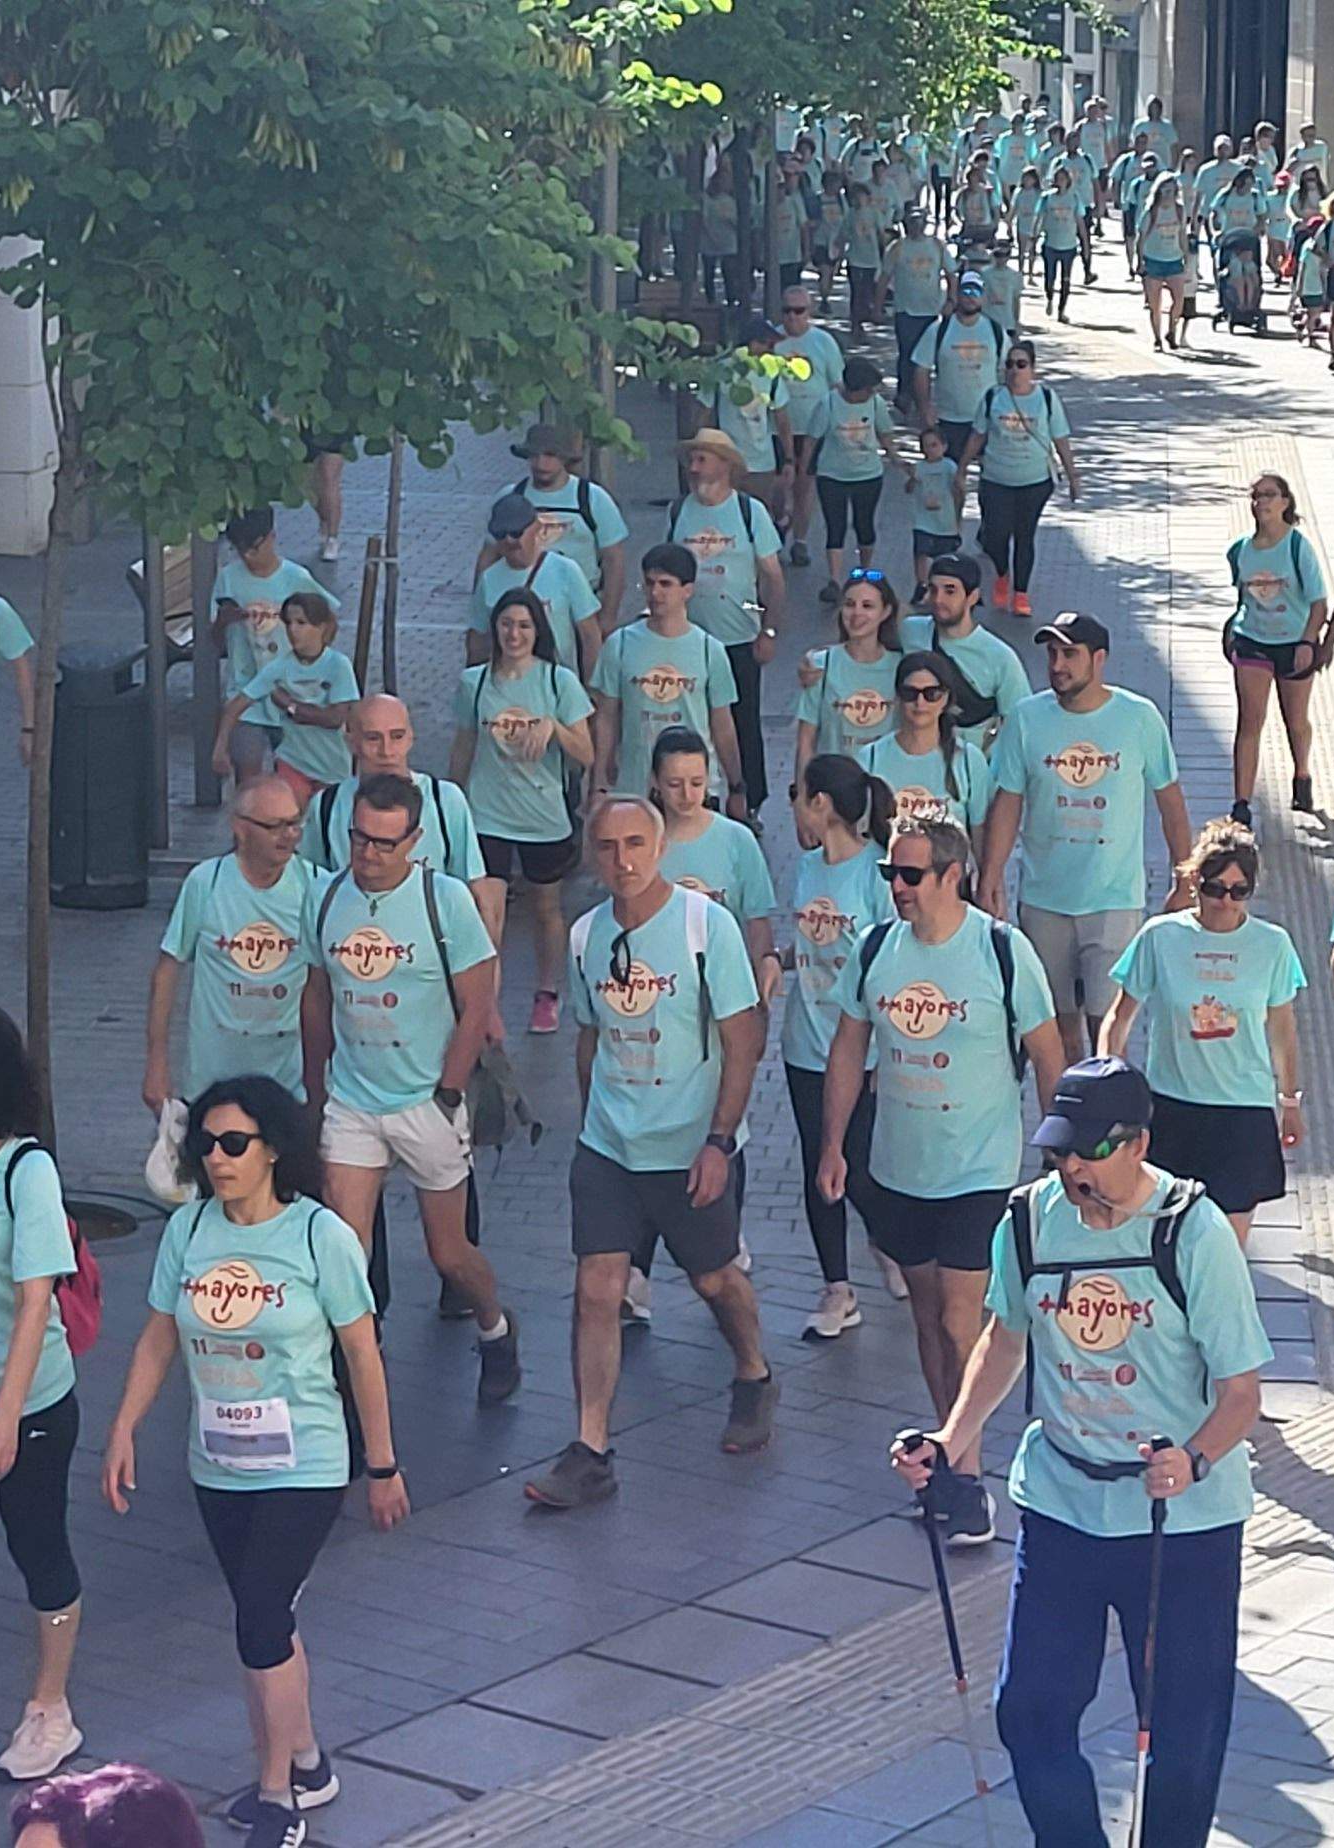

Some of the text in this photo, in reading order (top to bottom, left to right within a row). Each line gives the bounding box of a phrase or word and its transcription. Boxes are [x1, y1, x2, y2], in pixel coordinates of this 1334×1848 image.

[329, 941, 416, 968] +mayores
[876, 996, 969, 1025] +mayores
[182, 1280, 288, 1313] +mayores
